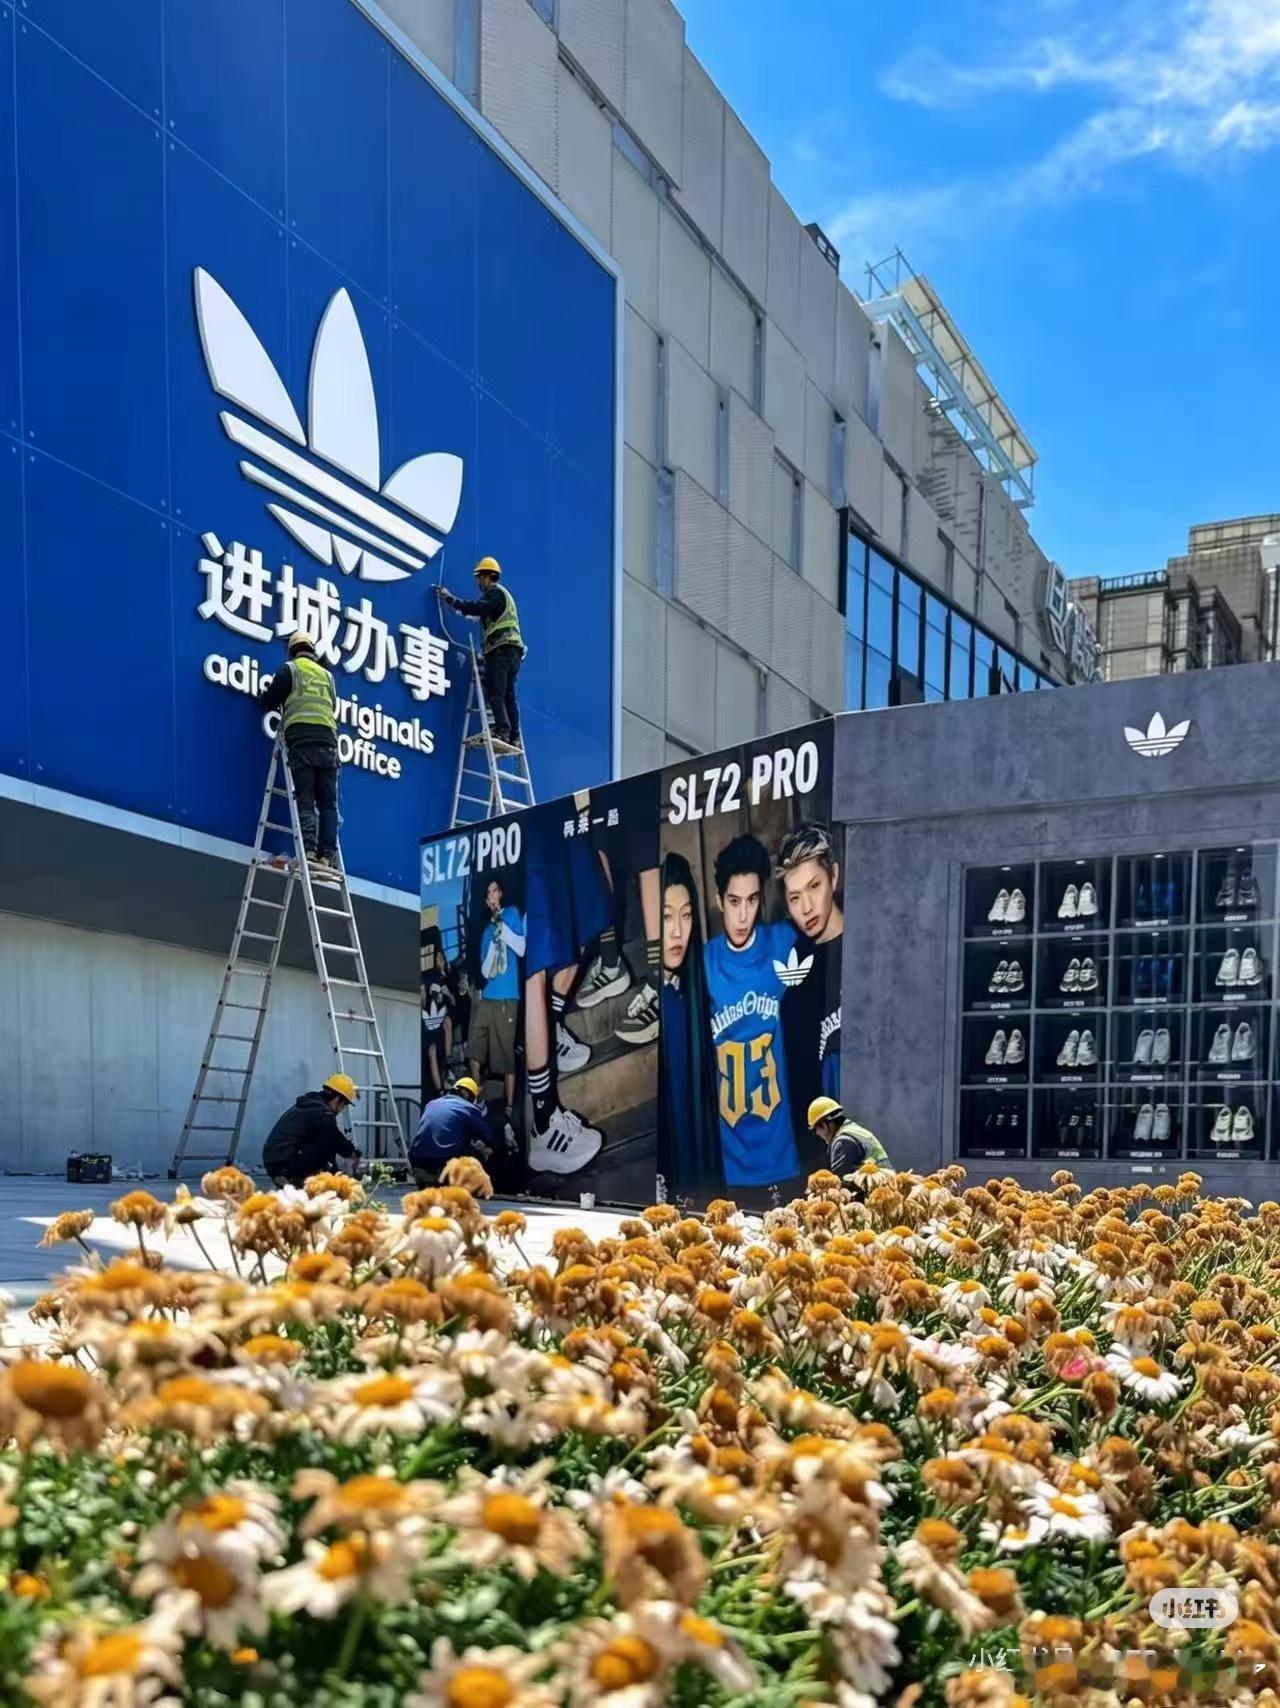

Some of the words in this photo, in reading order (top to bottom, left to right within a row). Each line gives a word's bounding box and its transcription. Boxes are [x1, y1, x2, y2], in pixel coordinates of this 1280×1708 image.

[198, 532, 451, 701] 进城办事
[333, 694, 434, 754] riginals
[337, 733, 402, 779] Office
[668, 762, 741, 825] SL72
[752, 741, 819, 806] PRO
[422, 836, 470, 886] SL72
[477, 822, 522, 873] PRO
[716, 1033, 781, 1128] 03
